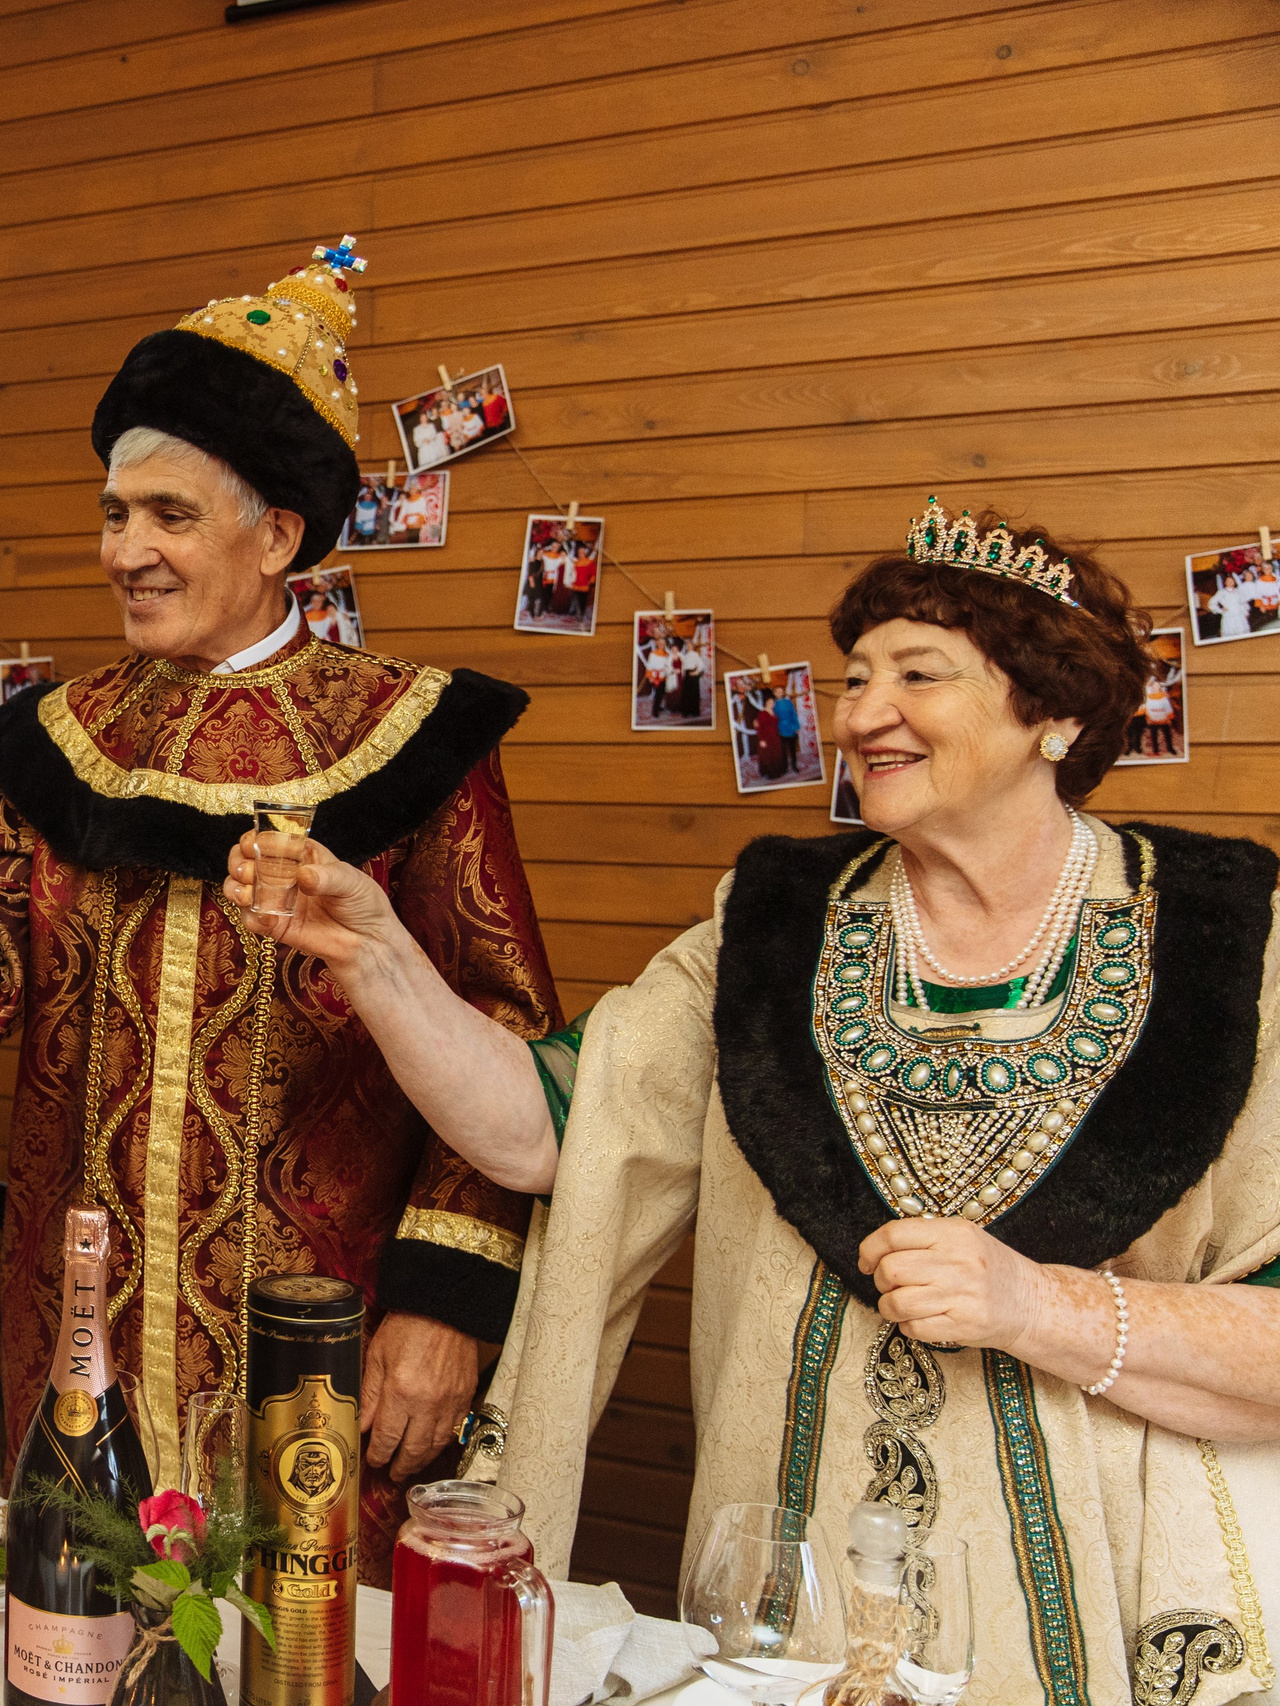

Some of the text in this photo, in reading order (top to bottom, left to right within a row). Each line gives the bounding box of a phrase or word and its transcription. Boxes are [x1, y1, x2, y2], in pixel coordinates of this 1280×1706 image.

[69, 1279, 96, 1379] MOËT
[287, 1583, 331, 1598] Gold
[28, 1623, 104, 1641] CHAMPAGNE
[13, 1643, 123, 1675] MOËT & CHANDON
[23, 1664, 110, 1685] ROSÉ IMPÉRIAL
